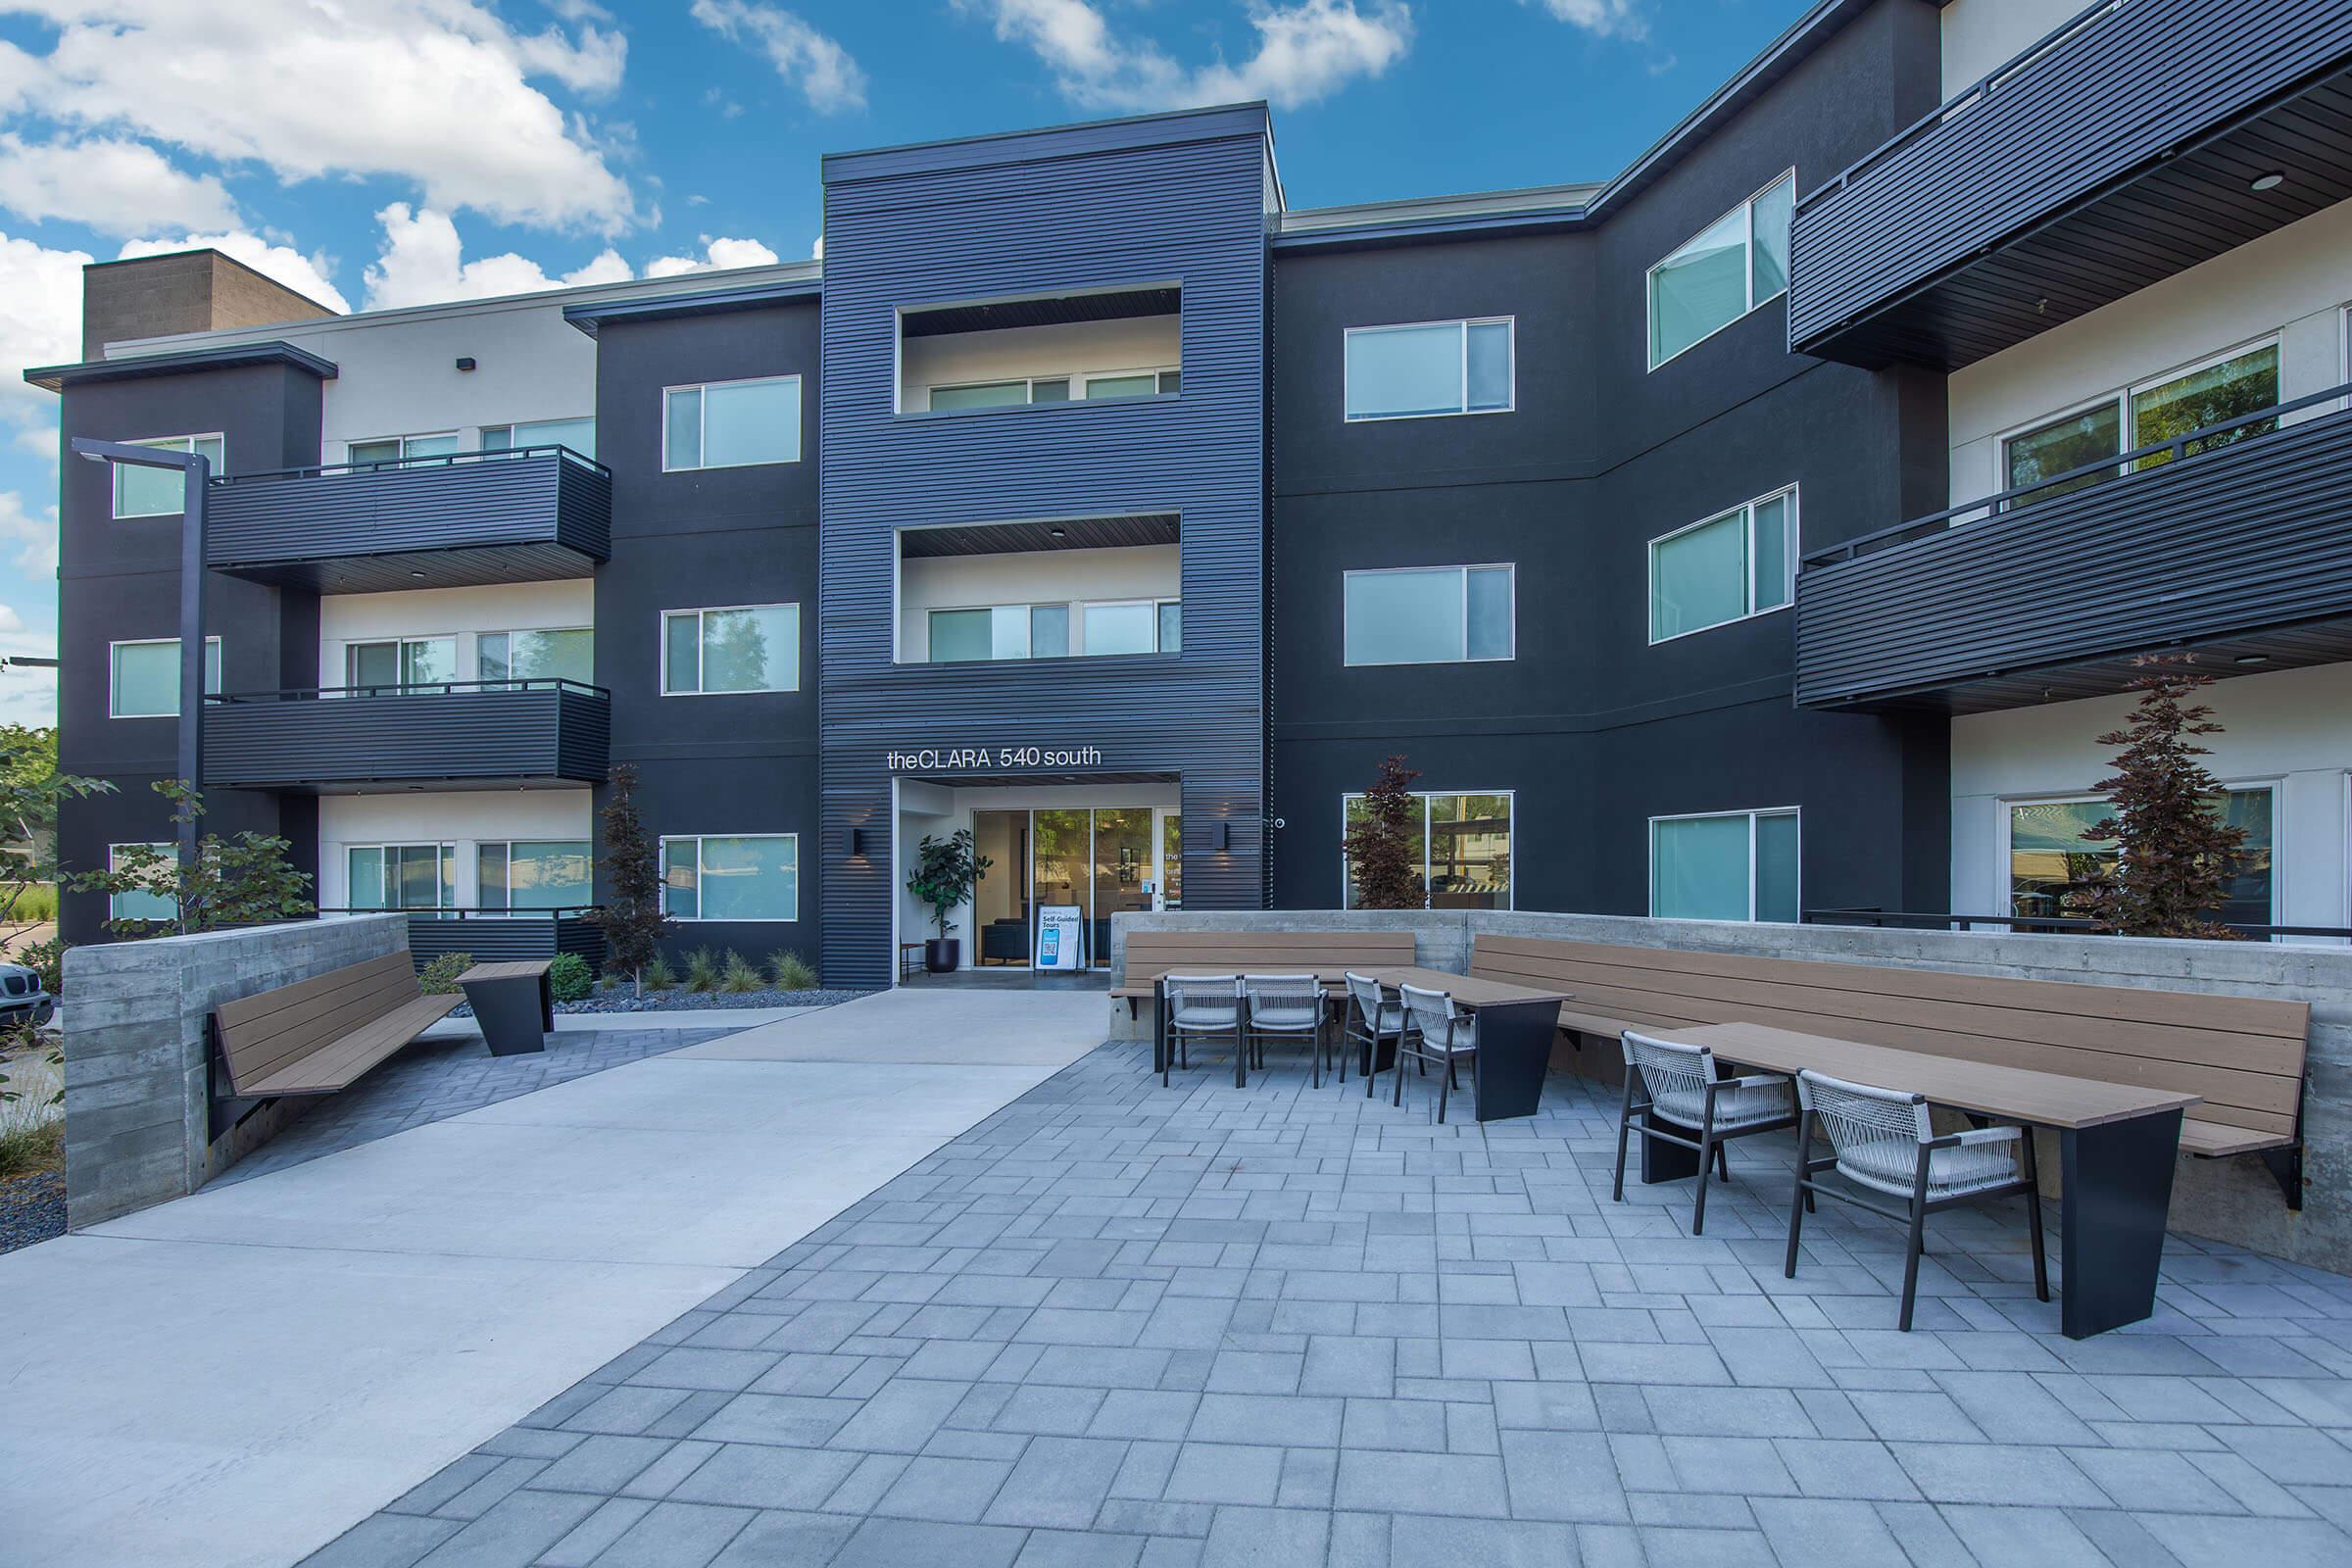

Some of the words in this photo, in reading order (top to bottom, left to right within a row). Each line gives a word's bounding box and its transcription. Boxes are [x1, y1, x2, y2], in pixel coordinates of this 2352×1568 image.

[887, 749, 992, 769] theCLARA
[1000, 747, 1040, 767] 540
[1044, 746, 1101, 766] south
